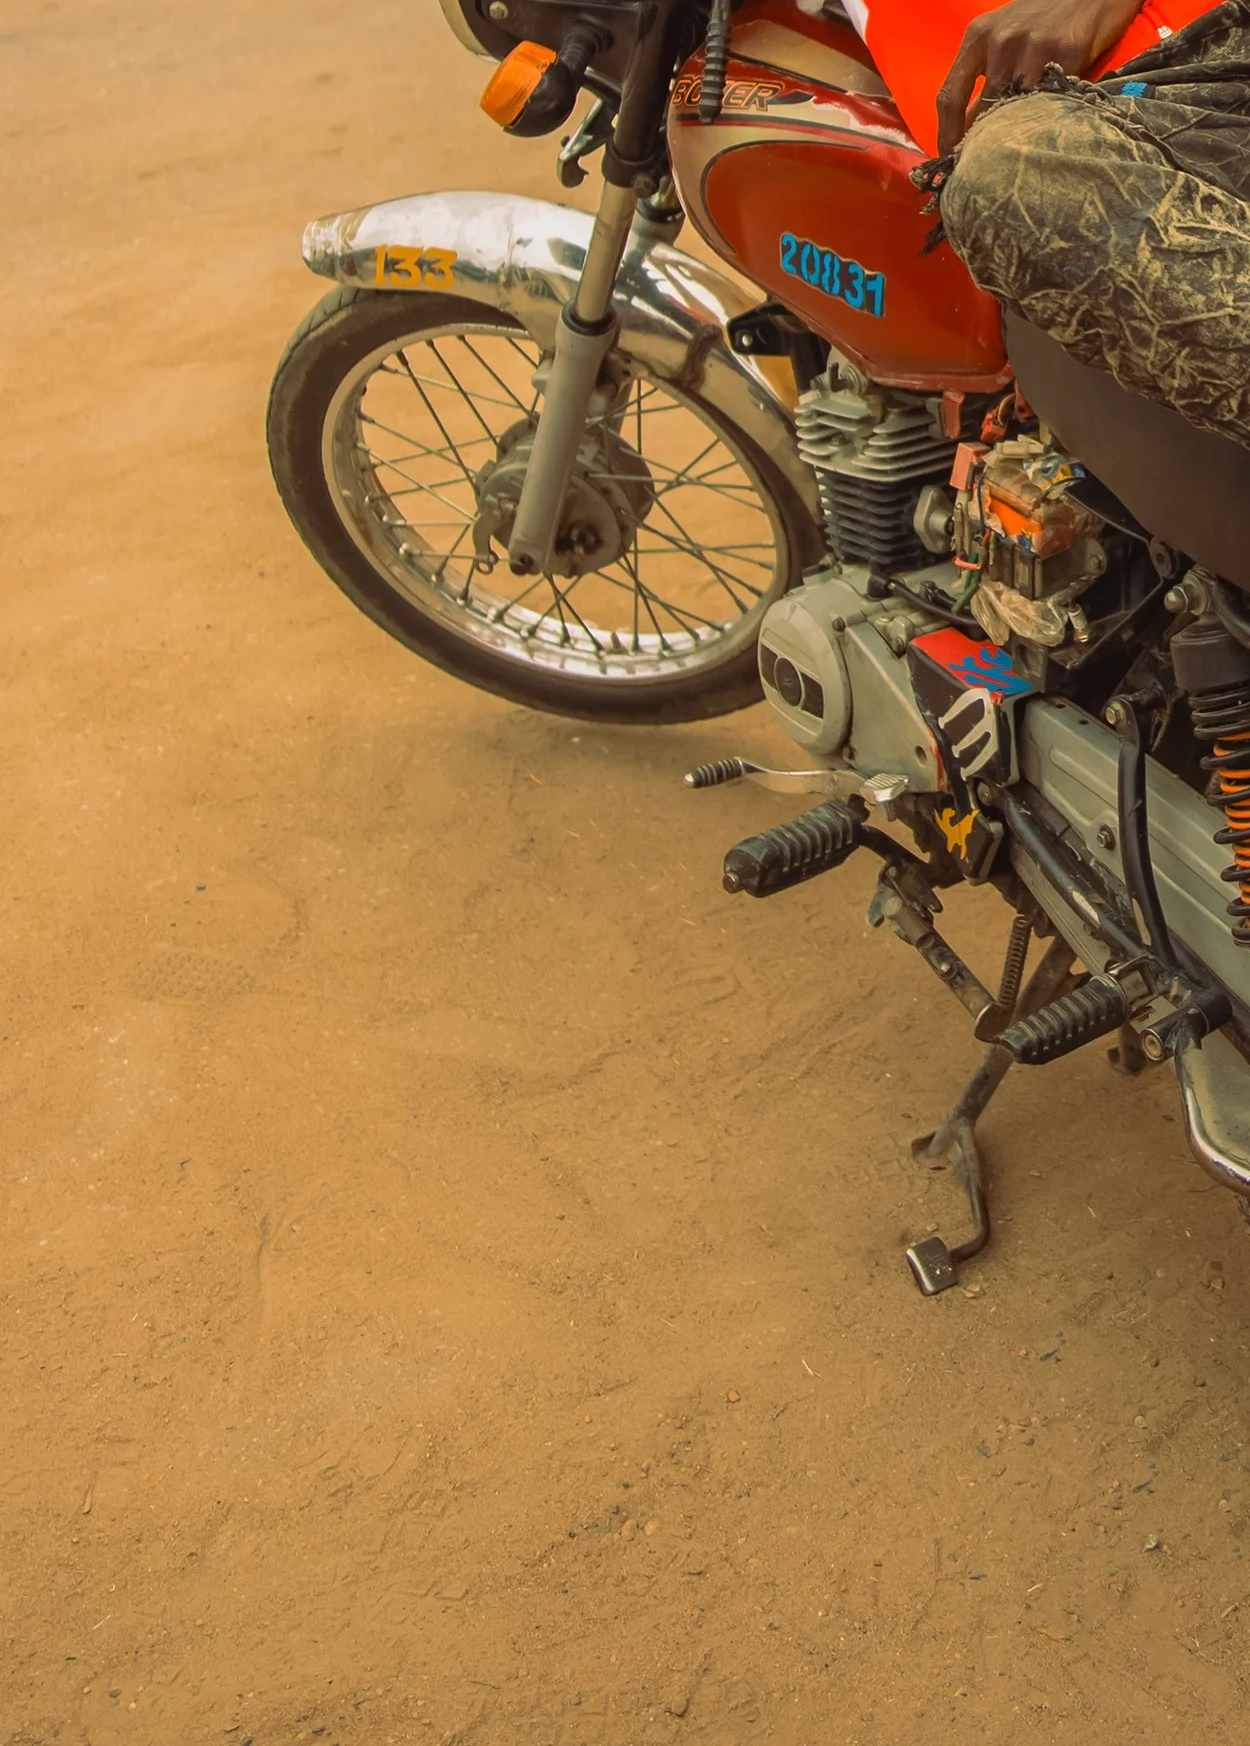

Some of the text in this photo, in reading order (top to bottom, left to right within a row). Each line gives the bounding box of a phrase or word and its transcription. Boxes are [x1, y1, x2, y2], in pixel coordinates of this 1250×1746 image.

[671, 78, 782, 112] BOER
[374, 244, 458, 290] 133
[781, 232, 885, 318] 20831
